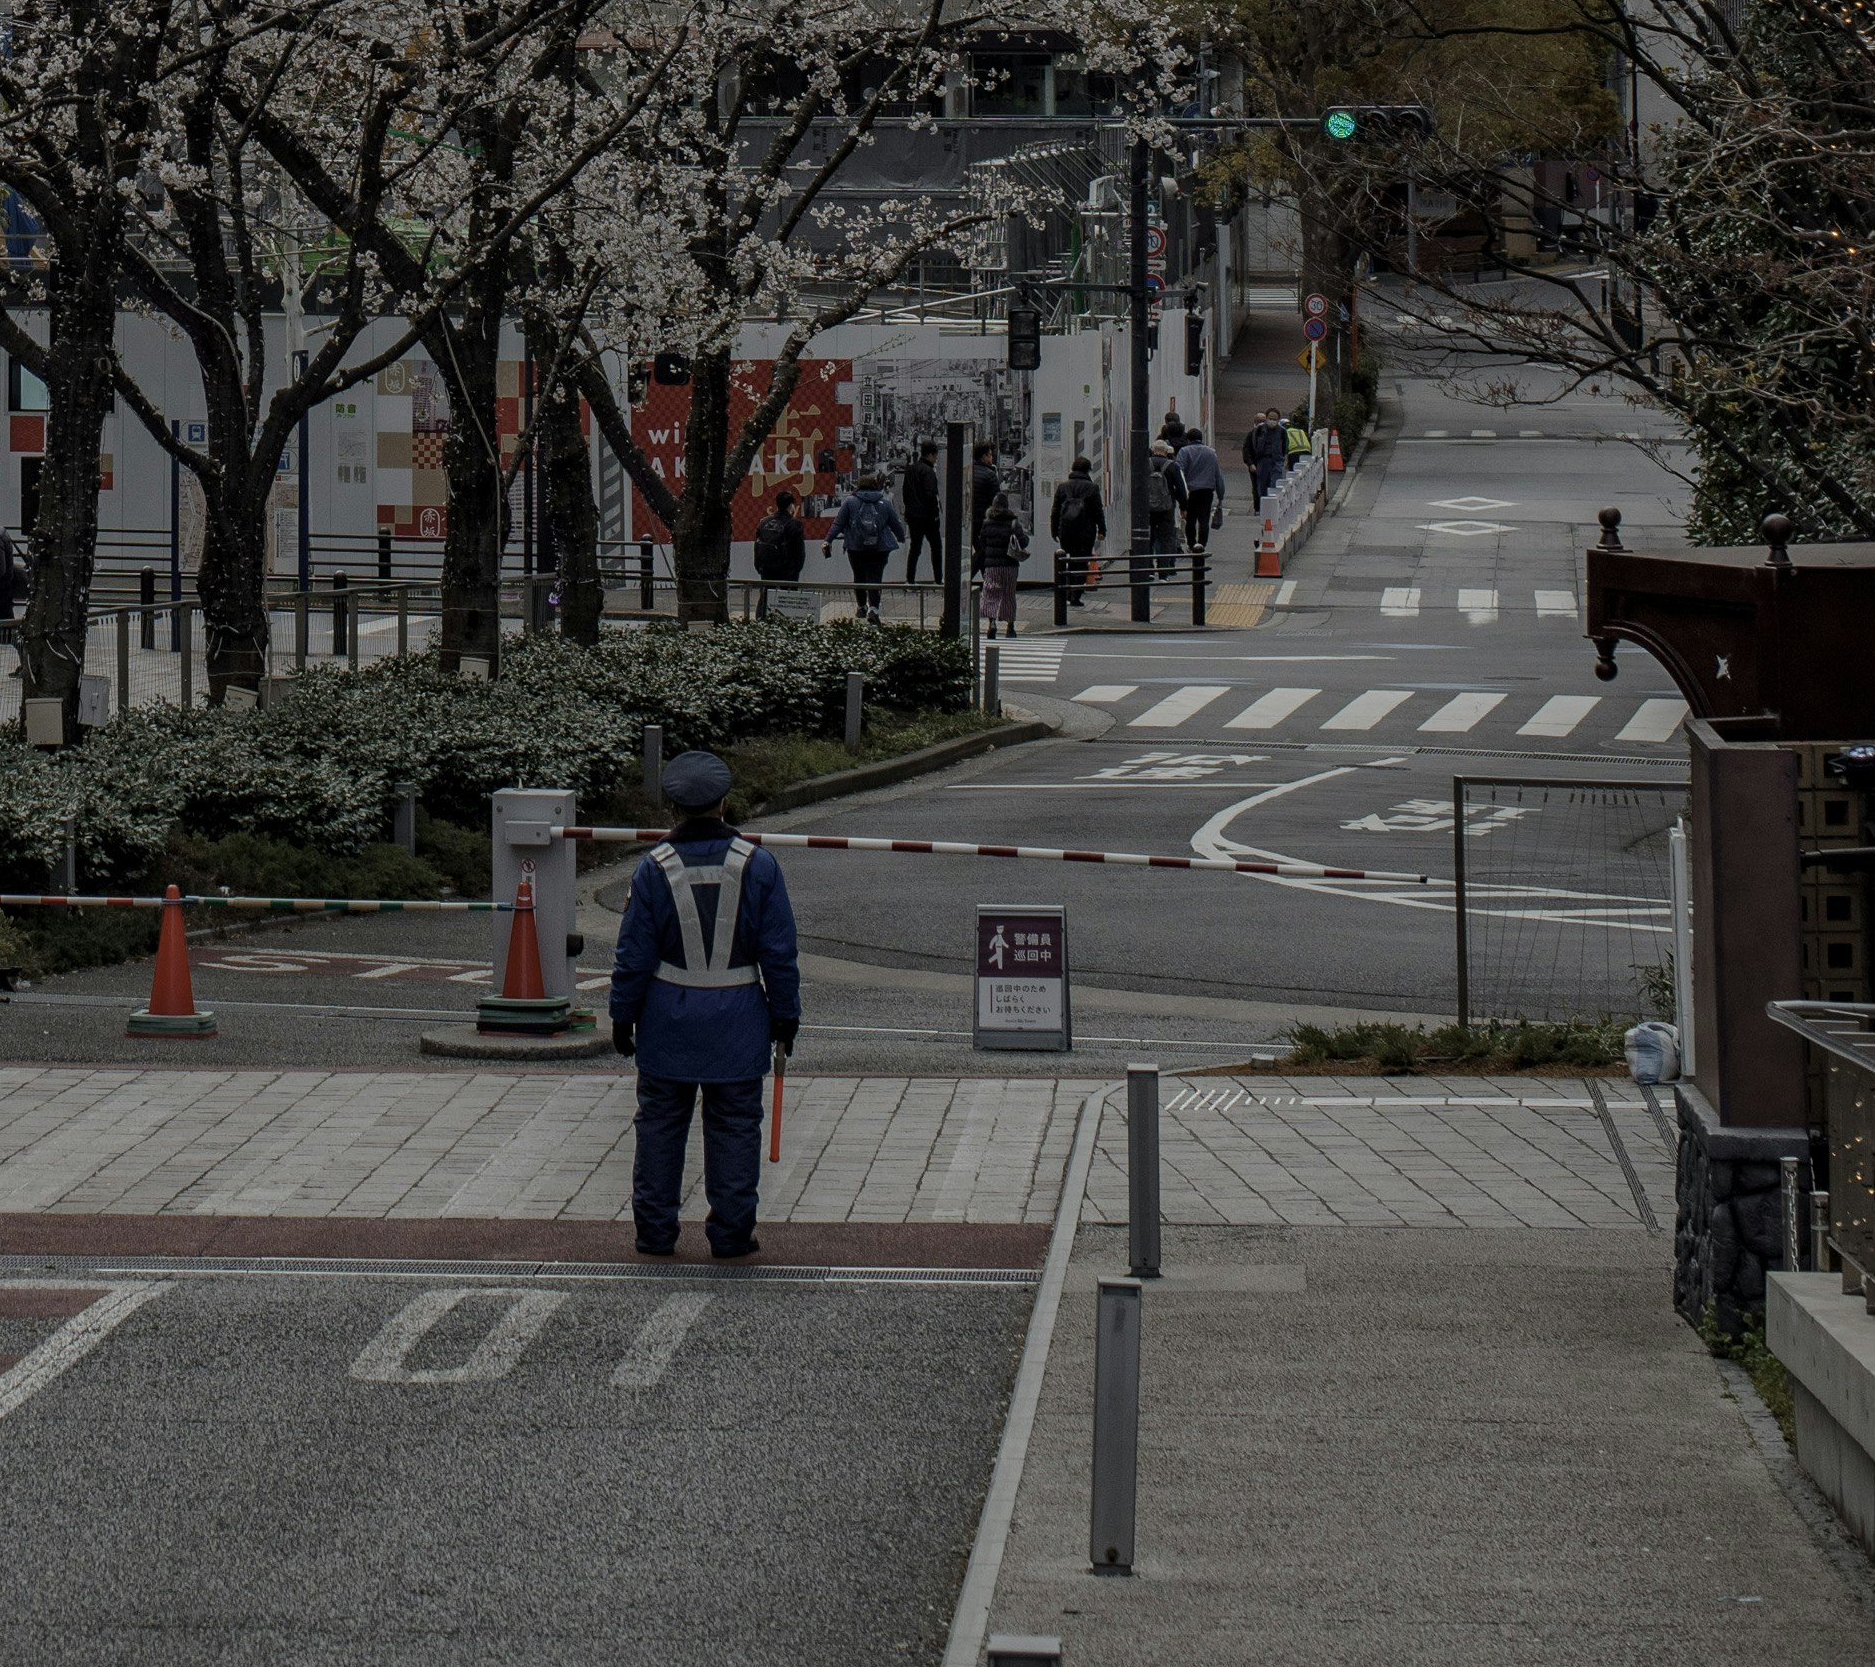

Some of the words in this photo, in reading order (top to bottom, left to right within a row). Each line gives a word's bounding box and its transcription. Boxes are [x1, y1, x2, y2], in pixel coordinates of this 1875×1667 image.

[1311, 300, 1323, 310] 30
[335, 403, 357, 414] 防音
[650, 453, 817, 479] AKAKA
[1013, 932, 1052, 947] 警備員
[1013, 949, 1052, 963] 巡回中
[995, 984, 1047, 994] 巡回中のため
[995, 995, 1025, 1003] しばらく
[995, 1005, 1052, 1015] お待ちください
